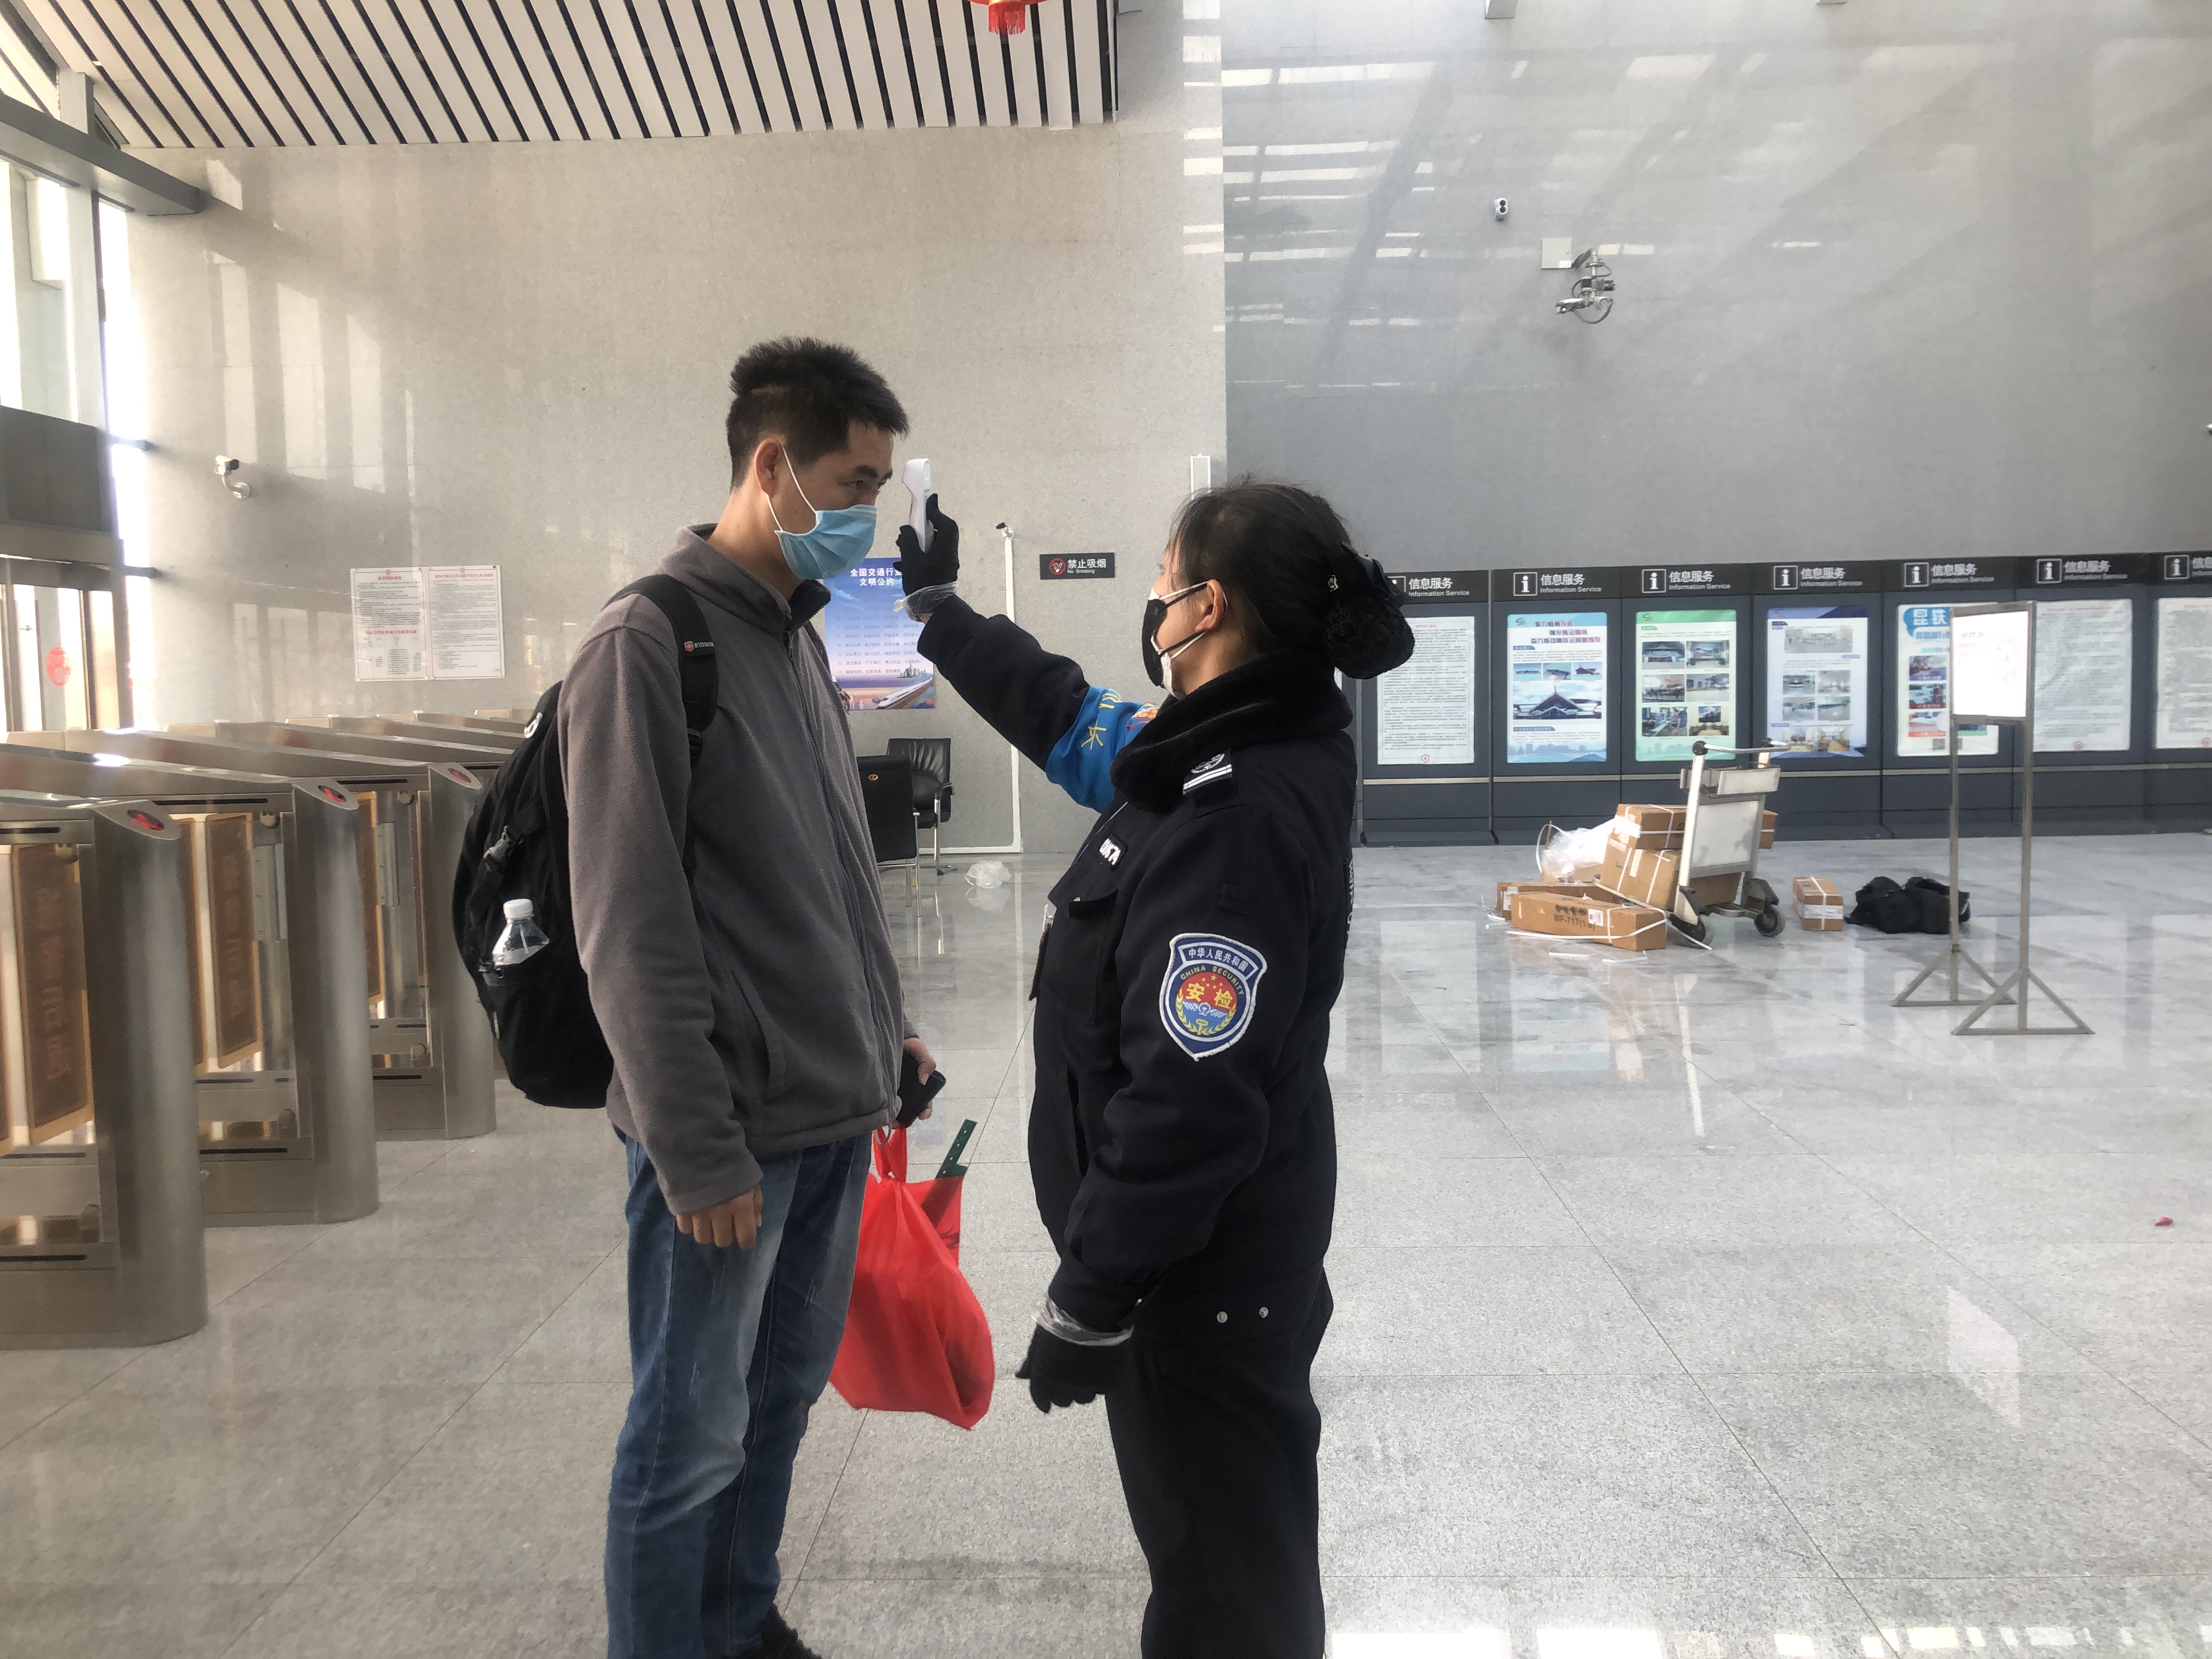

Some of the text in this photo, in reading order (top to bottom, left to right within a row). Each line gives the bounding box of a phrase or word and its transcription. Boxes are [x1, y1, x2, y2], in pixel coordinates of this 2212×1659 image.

[1067, 558, 1107, 569] 禁止吸烟
[850, 568, 902, 577] 全国交通行业
[1669, 571, 1714, 583] 信息服务
[1801, 567, 1846, 579] 信息服务
[860, 578, 894, 586] 文明公约
[1408, 577, 1453, 590] 信息服务
[1540, 573, 1585, 586] 信息服务
[1188, 947, 1249, 972] 中华人民共和国
[1181, 965, 1244, 995] CHINA SECURITY
[1186, 983, 1233, 1009] 安检
